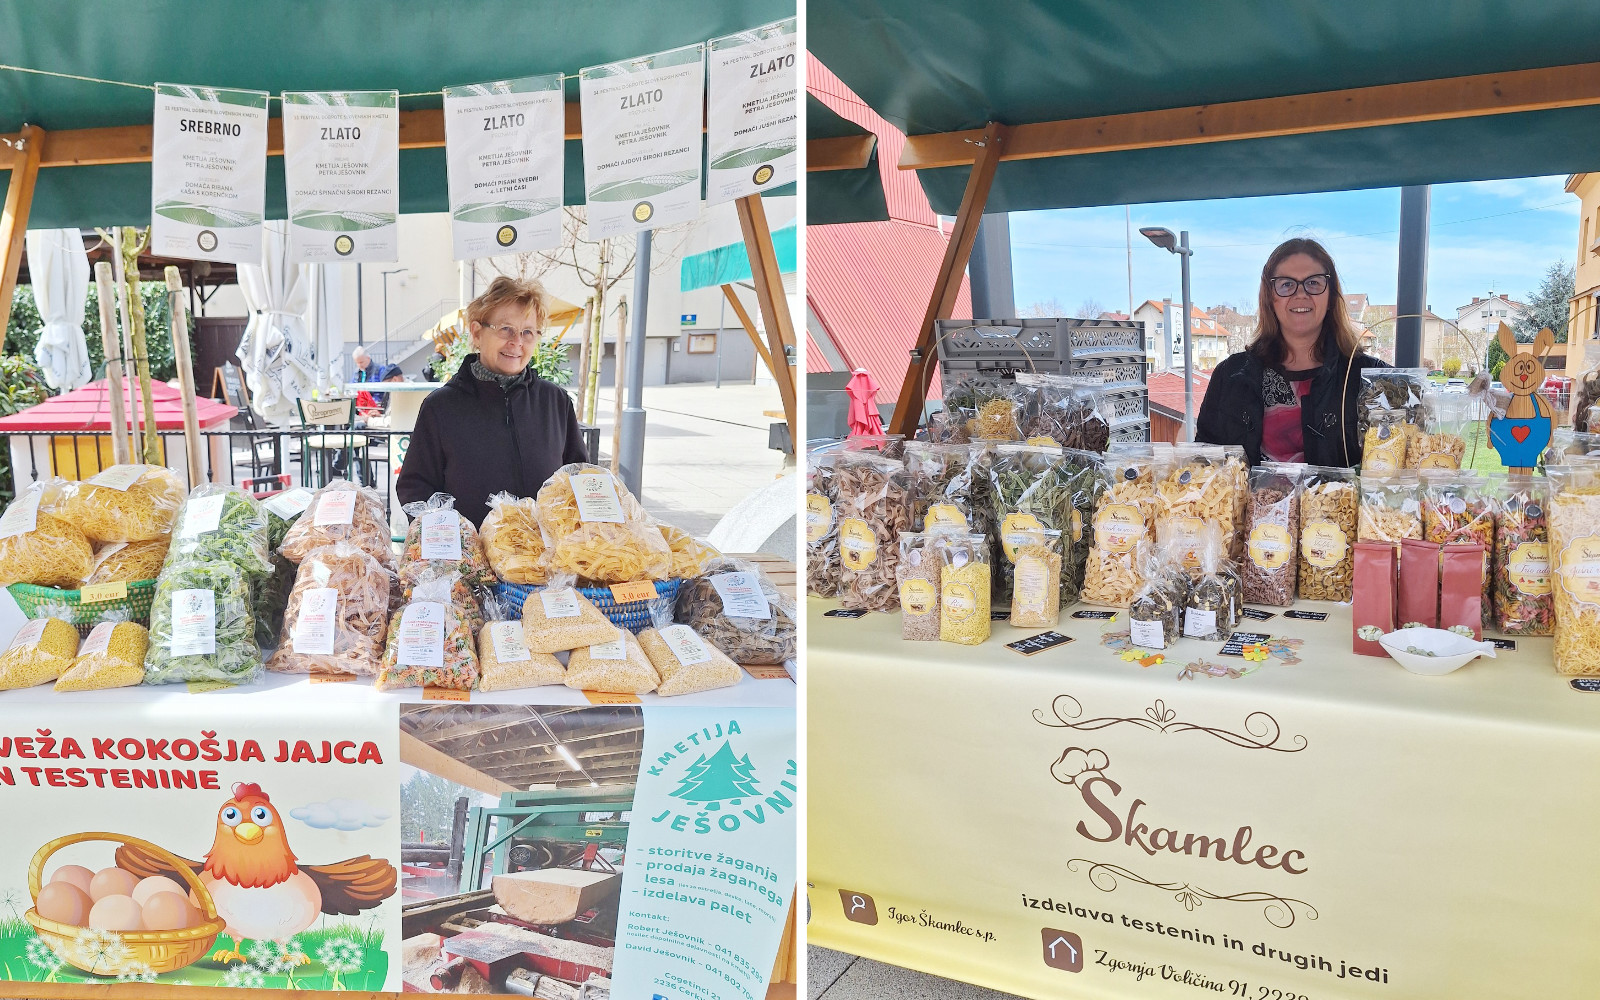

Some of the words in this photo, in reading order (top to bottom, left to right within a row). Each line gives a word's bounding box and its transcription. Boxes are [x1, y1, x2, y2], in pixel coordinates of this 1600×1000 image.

[750, 54, 795, 78] ZLATO
[620, 89, 663, 110] ZLATO
[743, 98, 768, 109] KMETIJA
[770, 88, 797, 101] JEŠOVNI
[745, 106, 764, 114] PETRA
[766, 96, 796, 108] JEŠOVNIK
[180, 119, 241, 136] SREBRNO
[484, 113, 525, 131] ZLATO
[615, 131, 640, 140] KMETIJA
[641, 124, 670, 134] JEŠOVNIK
[734, 126, 757, 136] DOMAČI
[321, 127, 361, 140] ZLATO
[618, 138, 638, 146] PETRA
[638, 131, 667, 141] JEŠOVNIK
[210, 156, 236, 165] JEŠOVNIK
[501, 156, 530, 165] JEŠOVNIK
[504, 150, 532, 158] JEŠOVNIK
[597, 160, 619, 170] DOMAČI
[621, 157, 642, 166] AJDOVI
[643, 152, 662, 160] ŠIROKI
[204, 163, 233, 171] JEŠOVNIK
[475, 180, 496, 188] DOMAČI
[92, 730, 266, 764] KOKOŠJA
[274, 740, 384, 765] JAJCA
[646, 720, 742, 777] KMETIJA
[20, 766, 220, 790] TESTENINE
[648, 846, 712, 860] storitve
[717, 852, 778, 882] žaganja
[645, 874, 674, 886] lesa
[646, 862, 705, 876] prodaja
[710, 867, 783, 907] žaganega
[629, 911, 670, 921] Kontakt:
[643, 888, 706, 906] izdelava
[710, 901, 752, 924] palet
[888, 906, 918, 924] Igor
[918, 909, 974, 936] Škamlec
[976, 929, 998, 942] s.p.
[628, 924, 660, 933] Robert
[662, 930, 704, 945] Ješovnik
[715, 944, 732, 957] 041
[734, 954, 750, 970] 835
[1022, 894, 1114, 924] izdelava
[1121, 914, 1216, 946] testenin
[1223, 934, 1244, 952] in
[1252, 942, 1332, 972] drugih
[1336, 960, 1388, 984] jedi
[626, 943, 652, 952] David
[654, 948, 696, 964] Ješovnik
[705, 964, 722, 977] 041
[724, 974, 740, 990] 802
[1094, 948, 1157, 982] Zgornja
[1158, 964, 1226, 993] Voličina
[654, 978, 676, 989] 2236
[679, 987, 704, 1000] Cerk
[665, 972, 708, 995] Cogetinci
